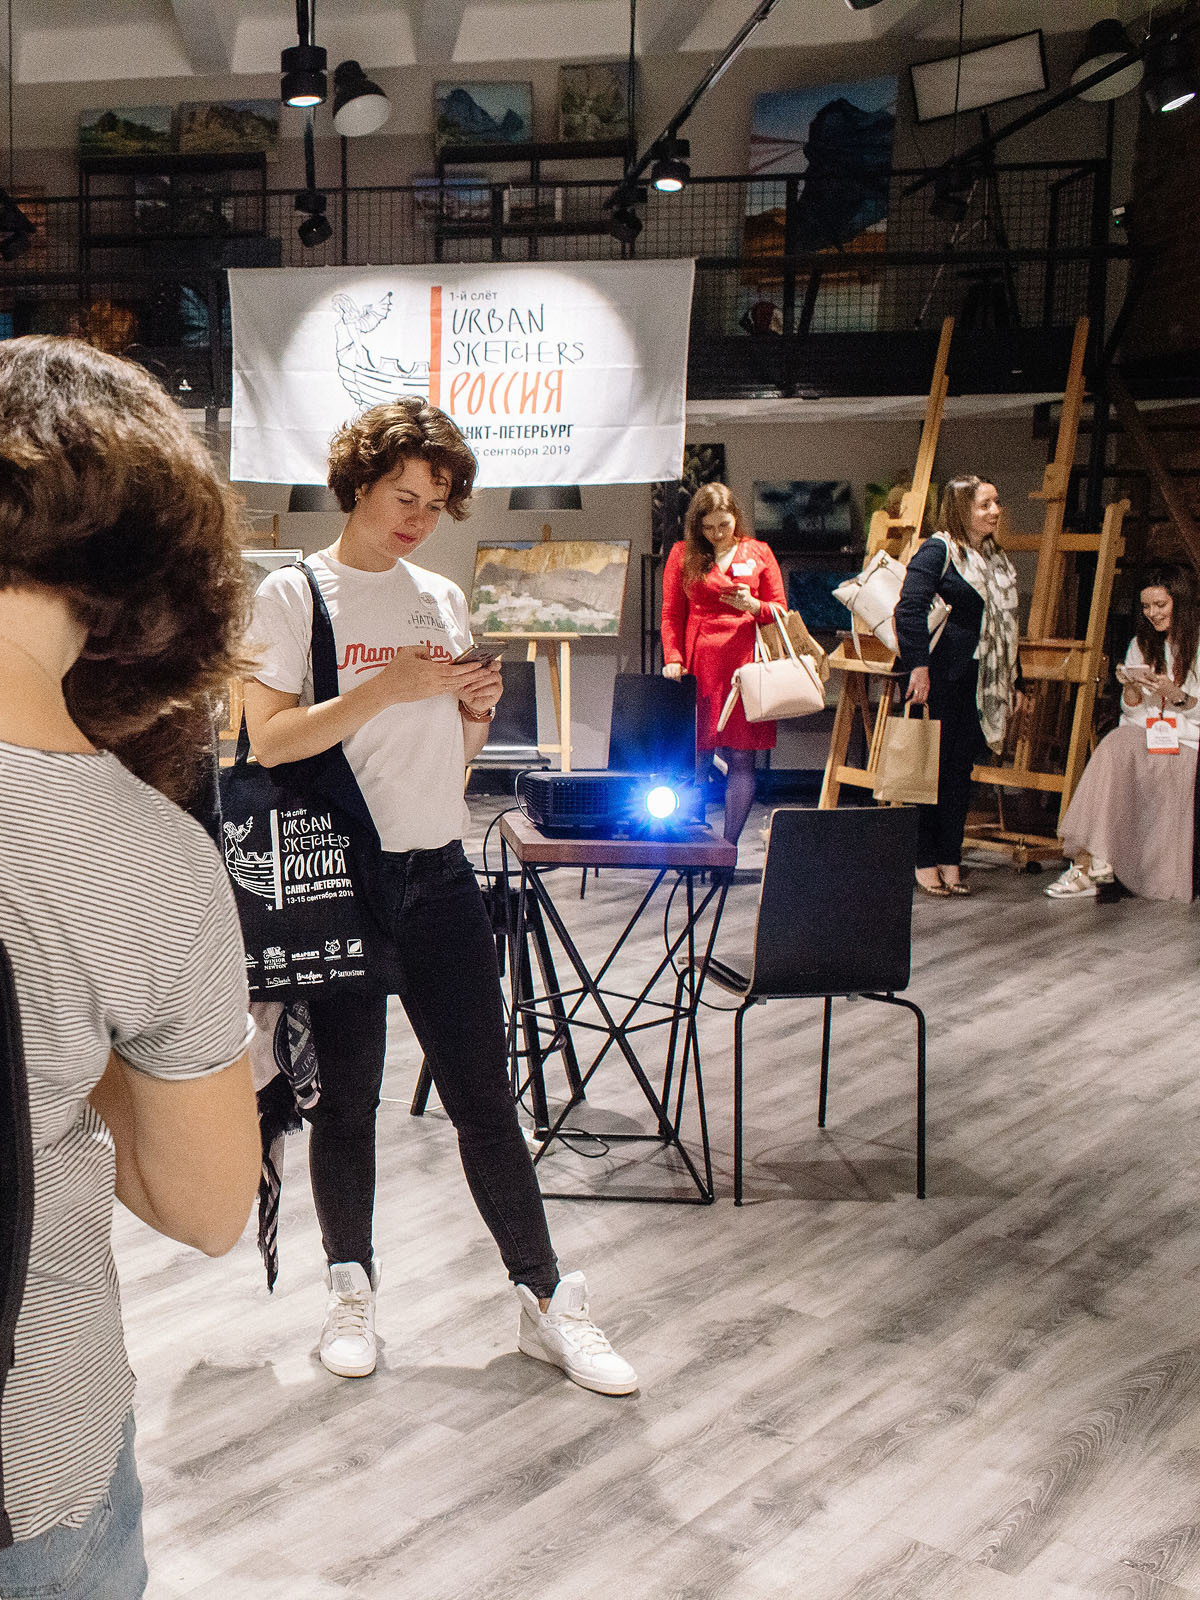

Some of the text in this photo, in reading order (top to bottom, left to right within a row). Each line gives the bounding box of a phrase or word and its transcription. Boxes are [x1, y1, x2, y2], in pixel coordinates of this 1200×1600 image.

[450, 291, 498, 301] 1-й слёт
[452, 303, 544, 335] URBAN
[447, 340, 584, 367] SKETCHERS
[449, 369, 563, 415] РОССИЯ
[460, 424, 574, 440] НКТ-ПЕТЕРБУРГ
[483, 447, 539, 458] сентября
[542, 445, 571, 456] 2019
[283, 813, 332, 836] URBAN
[281, 833, 350, 853] SKETCHERS
[284, 849, 347, 881] РОССИЯ
[286, 895, 306, 904] 13-15
[307, 891, 338, 902] сентября
